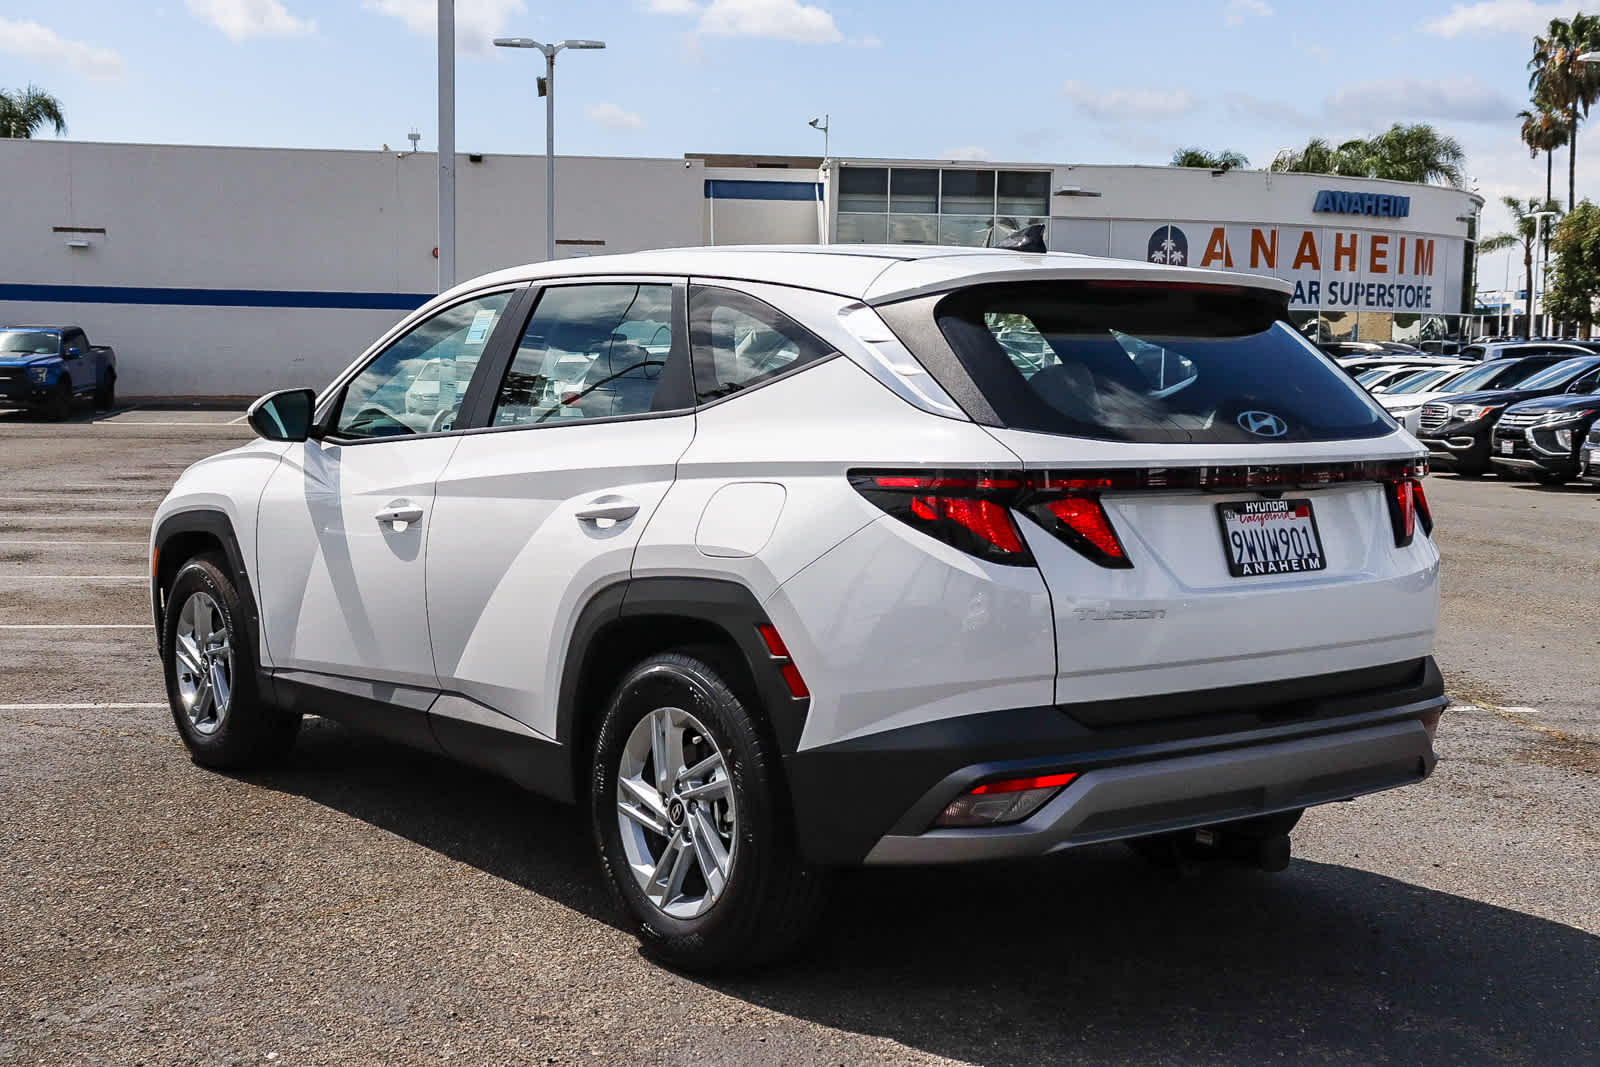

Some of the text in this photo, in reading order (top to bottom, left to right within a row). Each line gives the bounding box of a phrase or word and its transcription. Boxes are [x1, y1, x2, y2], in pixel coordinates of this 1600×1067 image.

[1313, 190, 1410, 217] ANAHEIM
[1200, 227, 1434, 276] ANAHEIM
[1289, 280, 1432, 308] AR SUPERSTORE
[1239, 511, 1296, 527] California
[1245, 501, 1288, 512] HYUNDAI
[1231, 526, 1318, 563] 9WVW901
[1243, 558, 1320, 575] ANAHEIM
